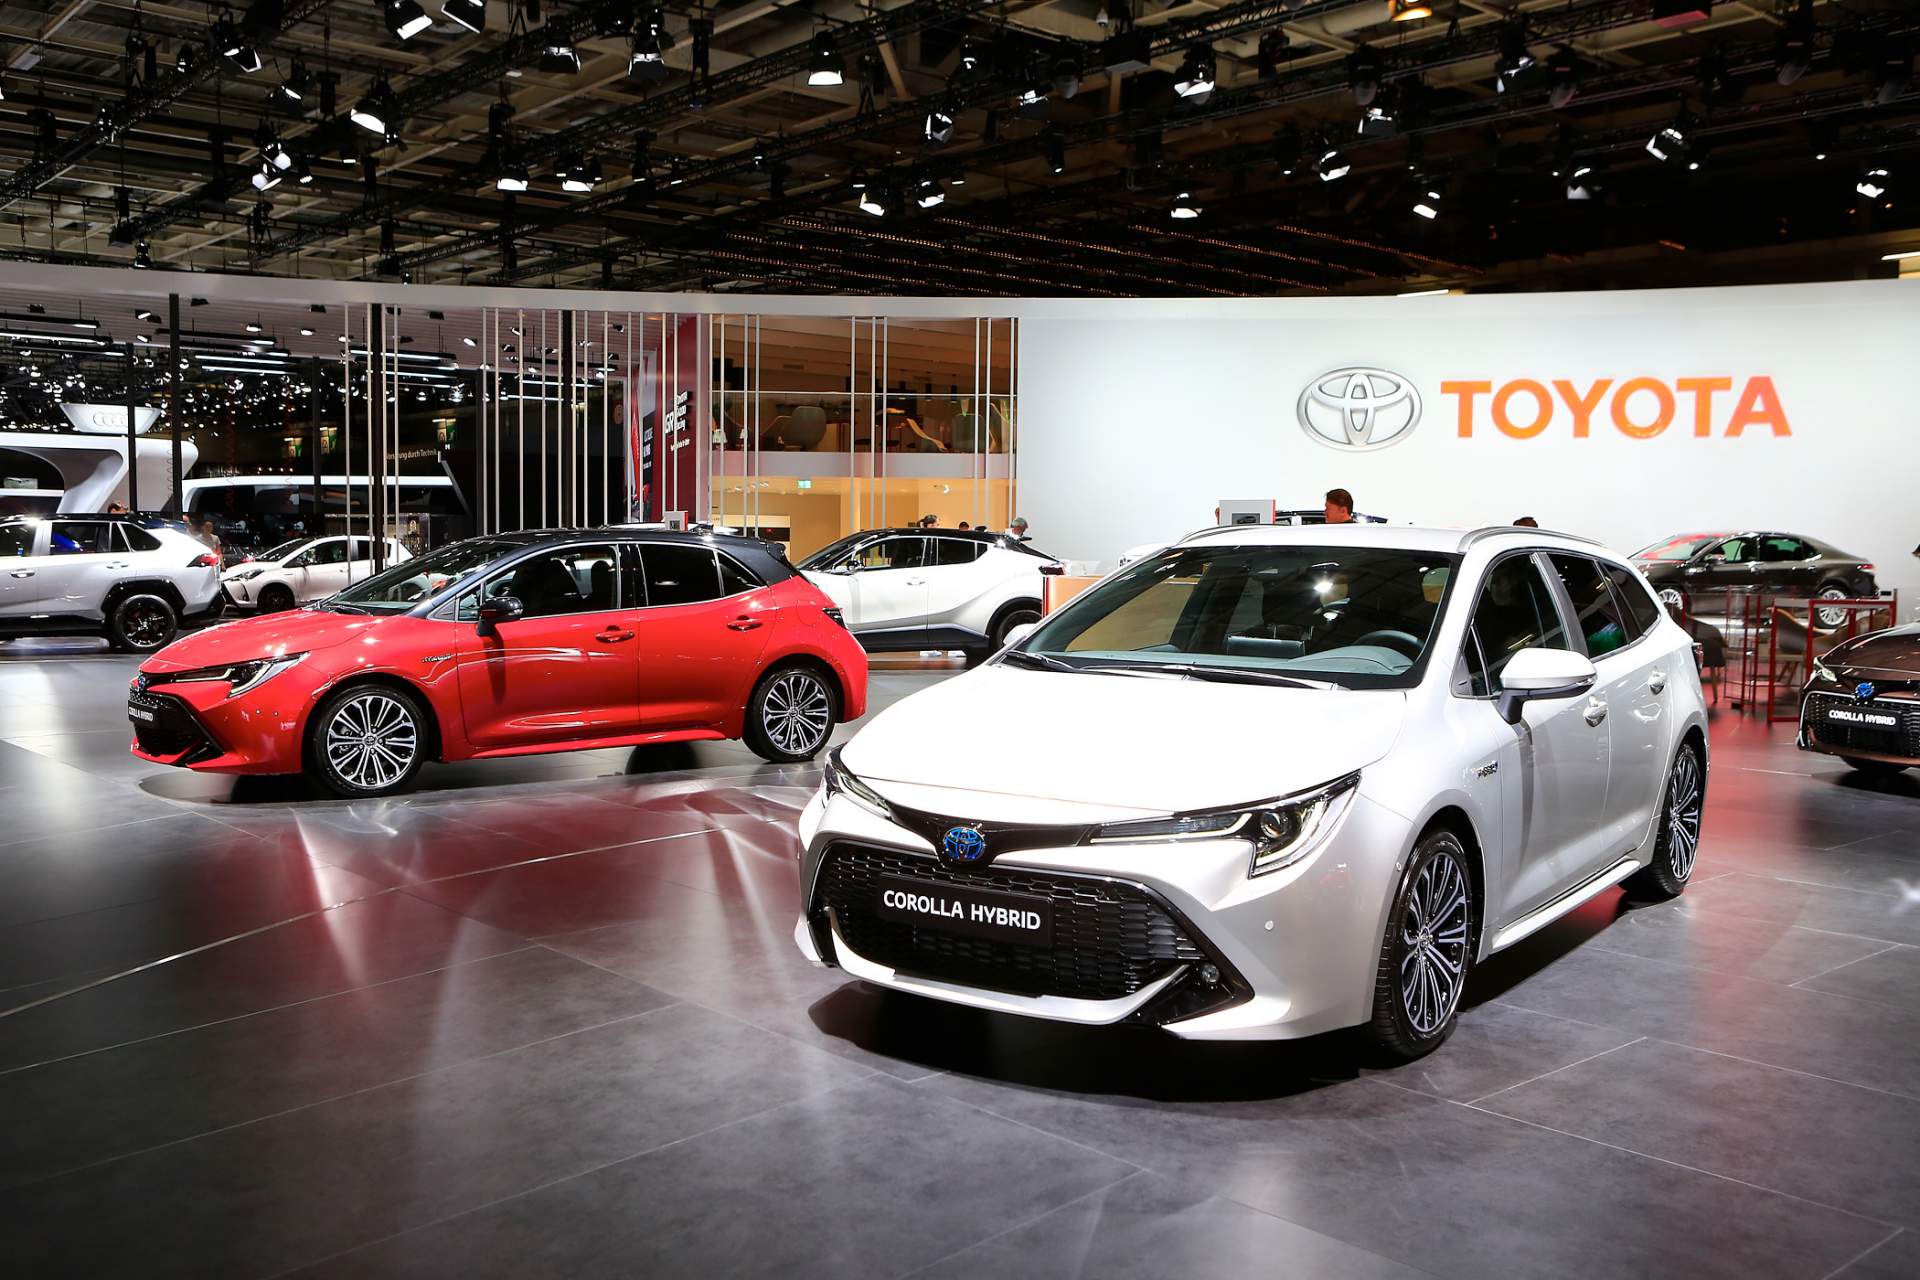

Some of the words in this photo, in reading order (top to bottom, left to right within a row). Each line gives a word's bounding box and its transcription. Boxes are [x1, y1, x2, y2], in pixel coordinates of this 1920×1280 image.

[1440, 376, 1792, 440] TOYOTA
[1828, 709, 1864, 722] COROLLA
[1864, 713, 1897, 726] HYBRID
[883, 889, 965, 919] COROLLA
[970, 903, 1041, 930] HYBRID
